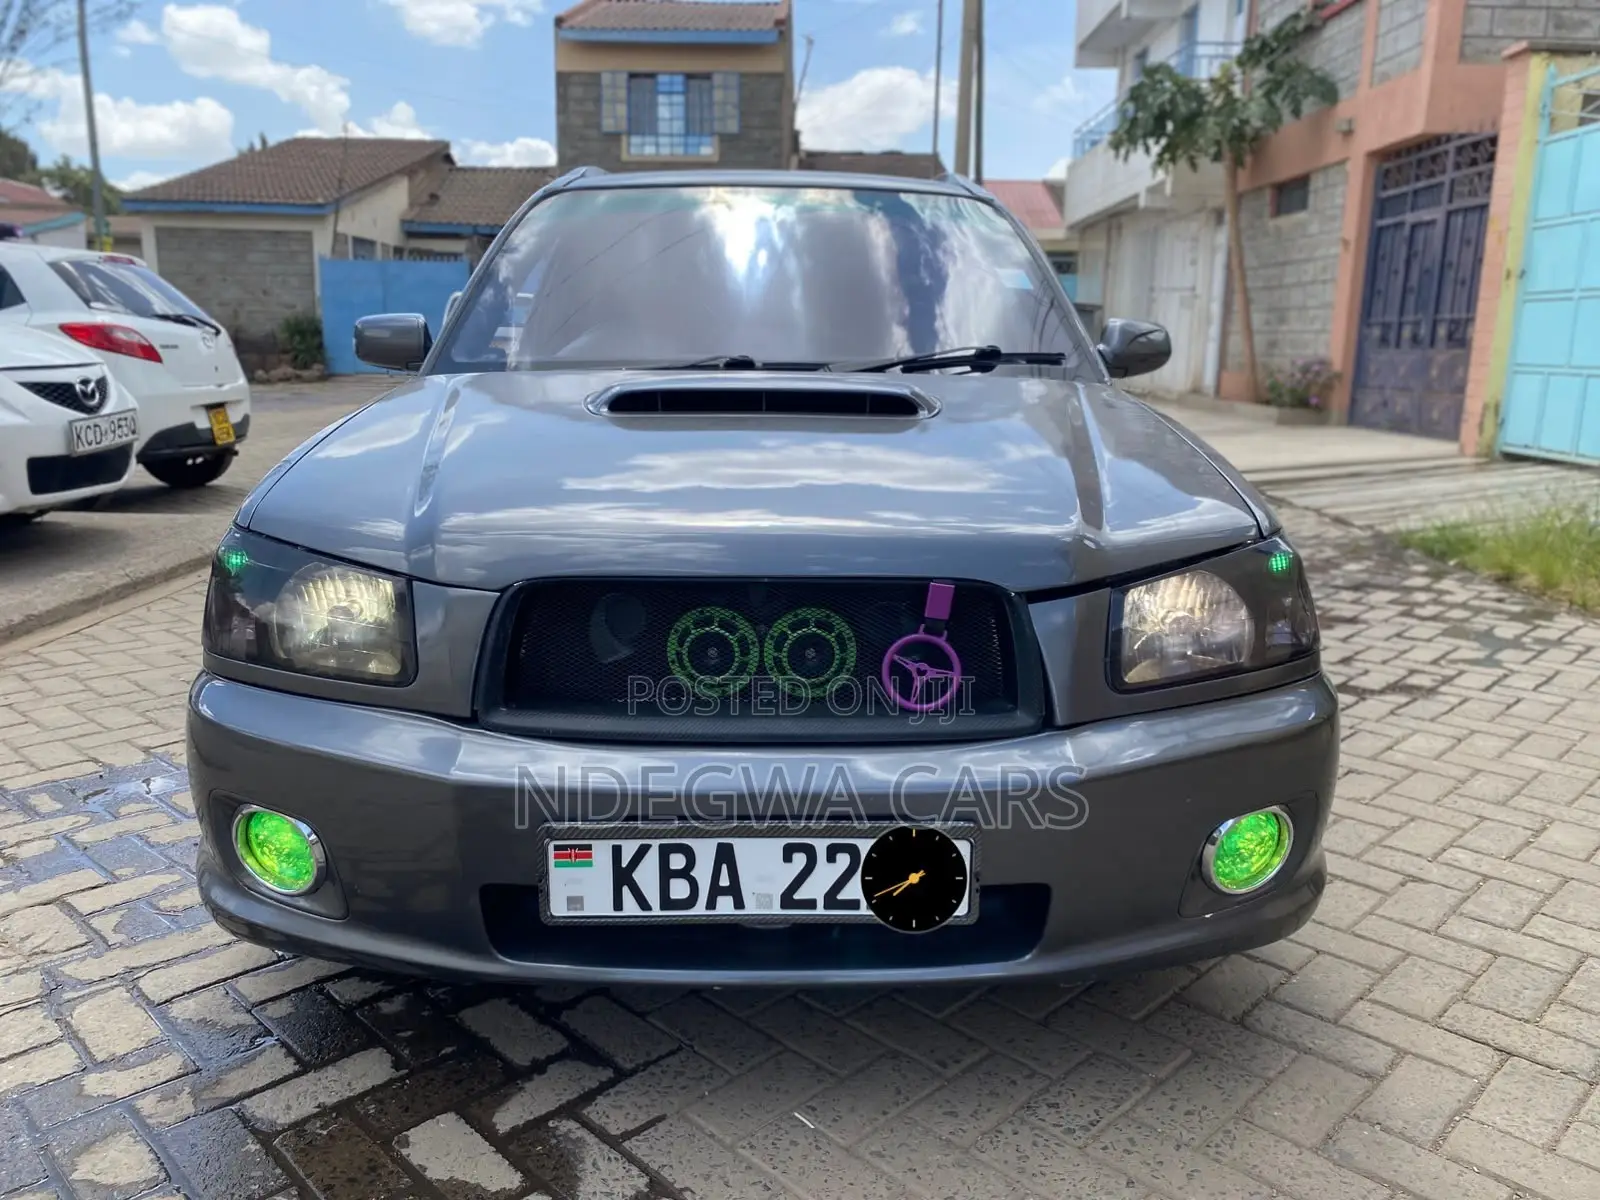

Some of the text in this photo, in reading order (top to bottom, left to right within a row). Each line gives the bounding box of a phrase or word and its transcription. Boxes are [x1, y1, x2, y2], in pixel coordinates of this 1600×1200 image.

[74, 423, 103, 450] KCD
[611, 841, 872, 912] KBA 22
